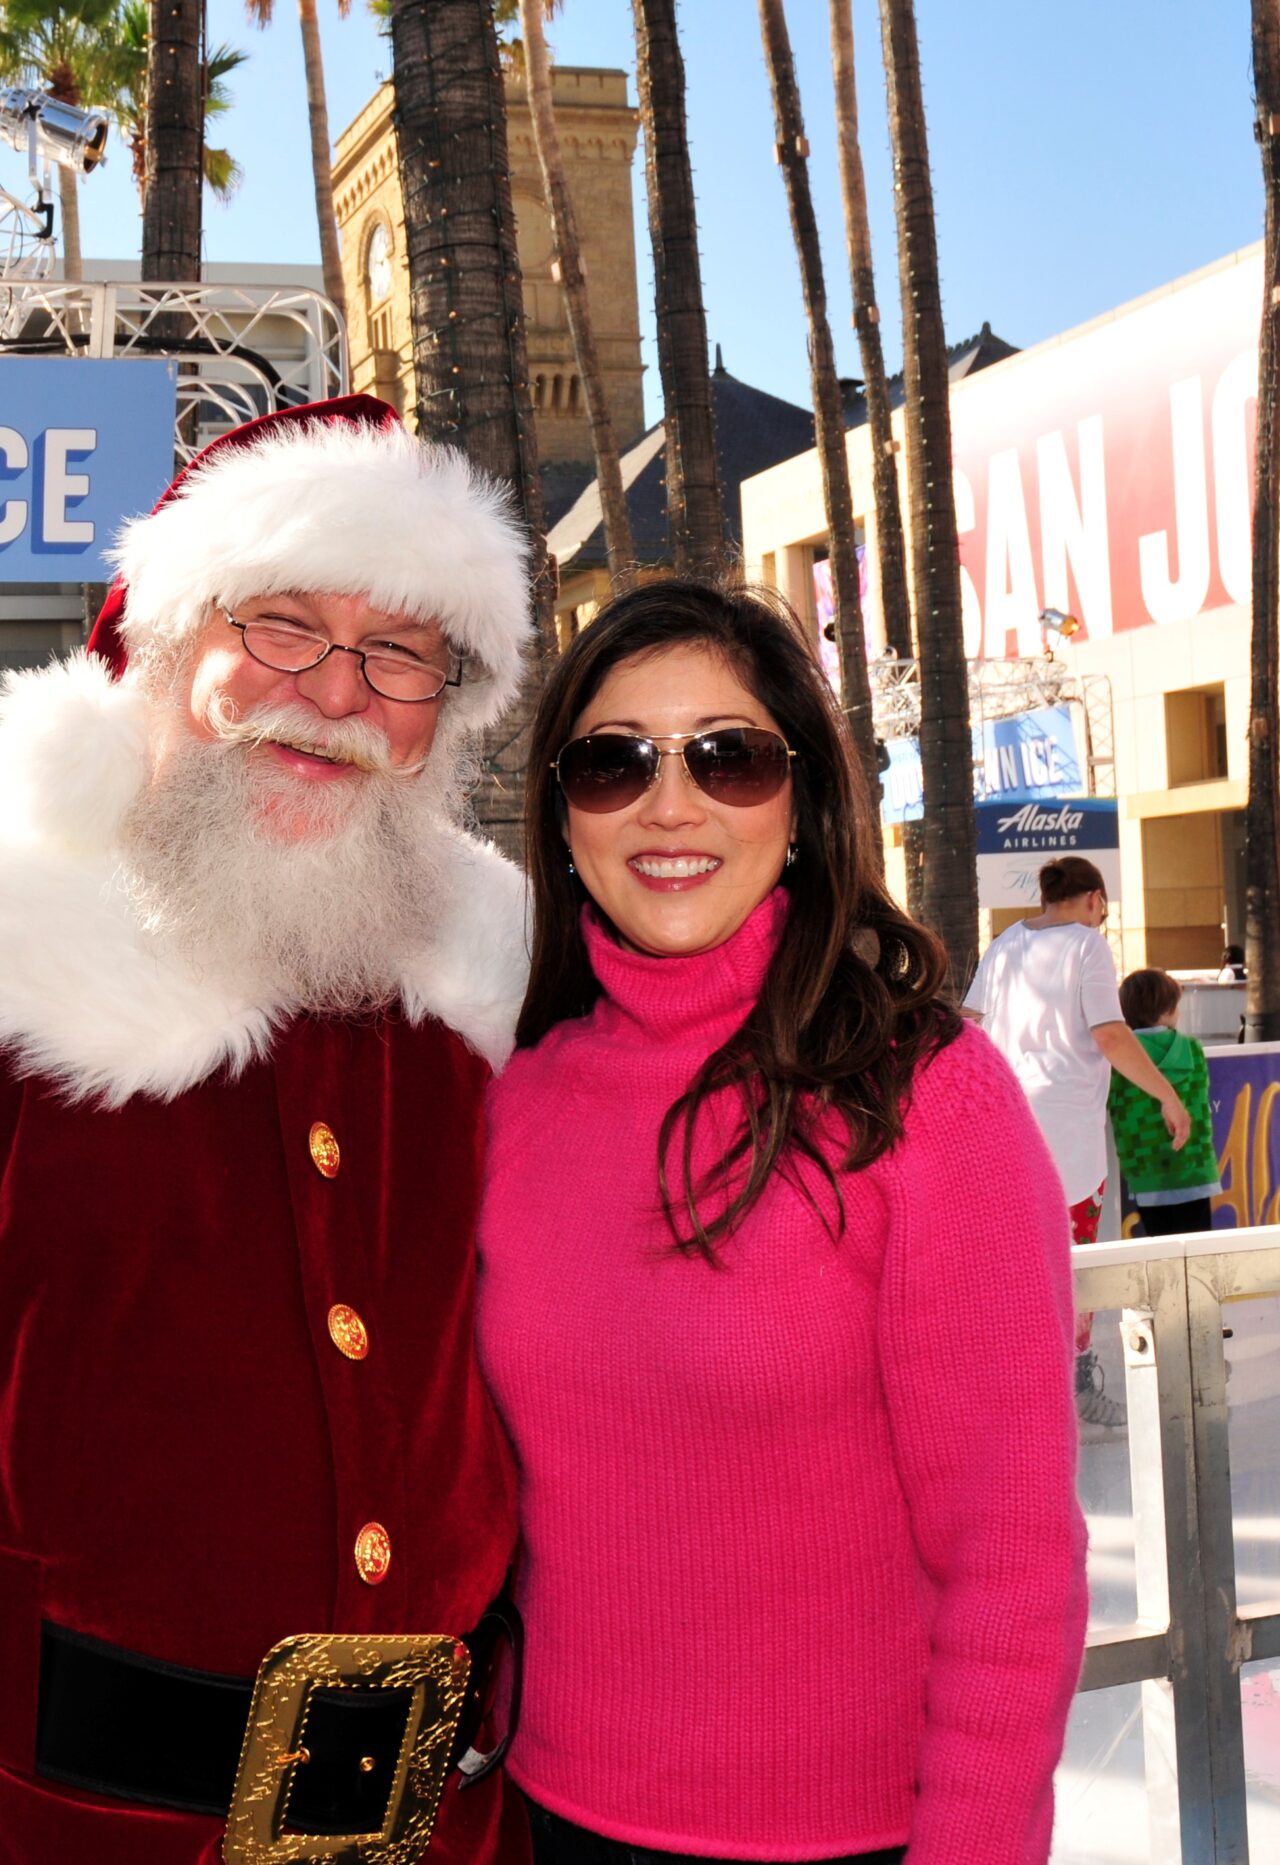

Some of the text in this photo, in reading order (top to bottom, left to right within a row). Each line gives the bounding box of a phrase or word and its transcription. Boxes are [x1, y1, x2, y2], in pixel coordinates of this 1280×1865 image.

[952, 413, 1113, 661] AN
[997, 803, 1084, 833] Alaska
[1004, 835, 1077, 849] AIRLINES
